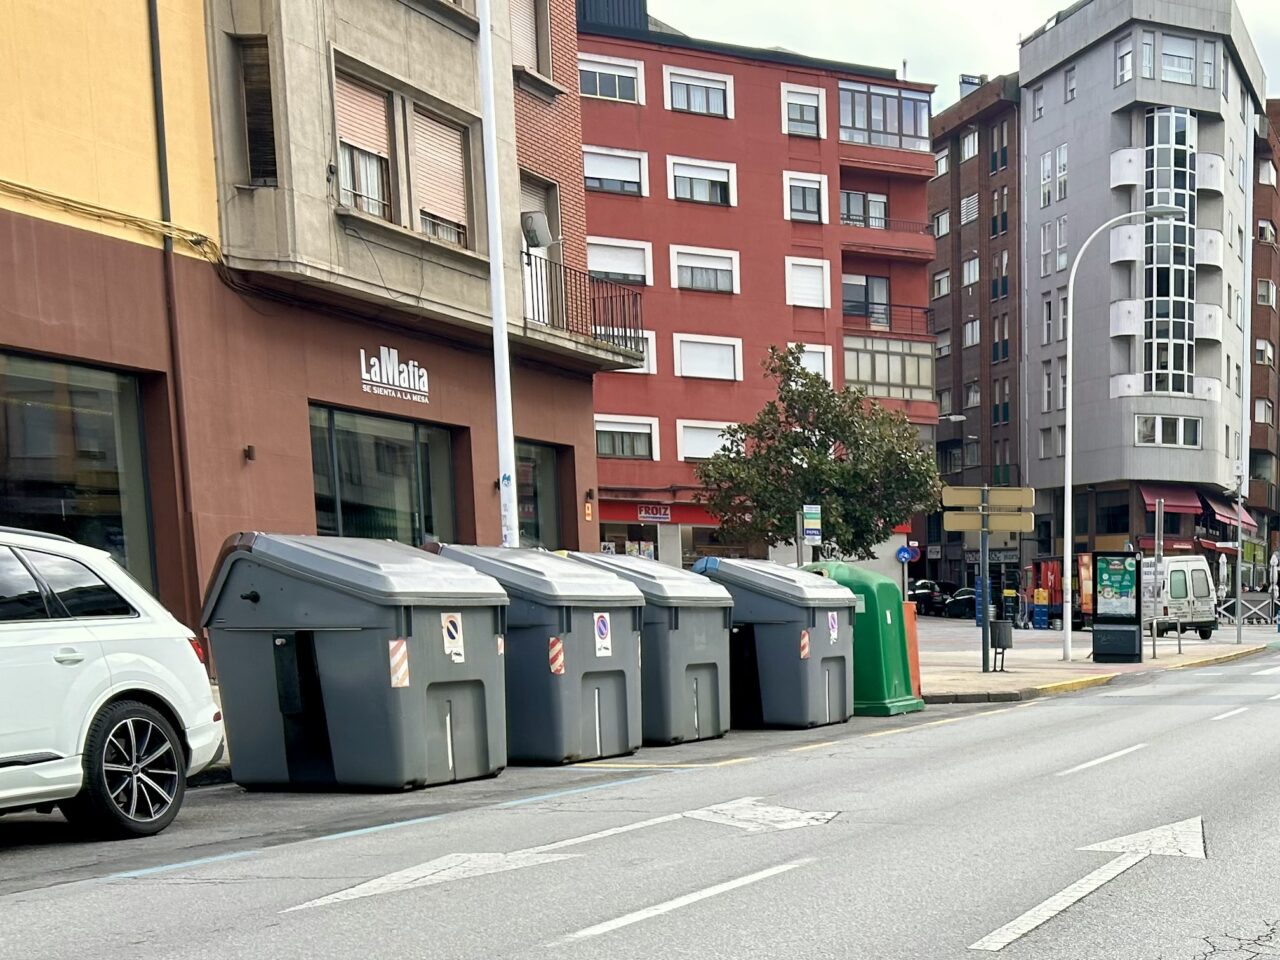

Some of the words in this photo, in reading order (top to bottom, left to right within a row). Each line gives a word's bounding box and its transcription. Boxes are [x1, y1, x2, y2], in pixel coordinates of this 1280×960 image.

[362, 384, 372, 393] SE
[373, 387, 396, 398] SIENTA
[402, 392, 412, 401] LA
[412, 394, 429, 404] MESA
[639, 506, 669, 516] FROIZ
